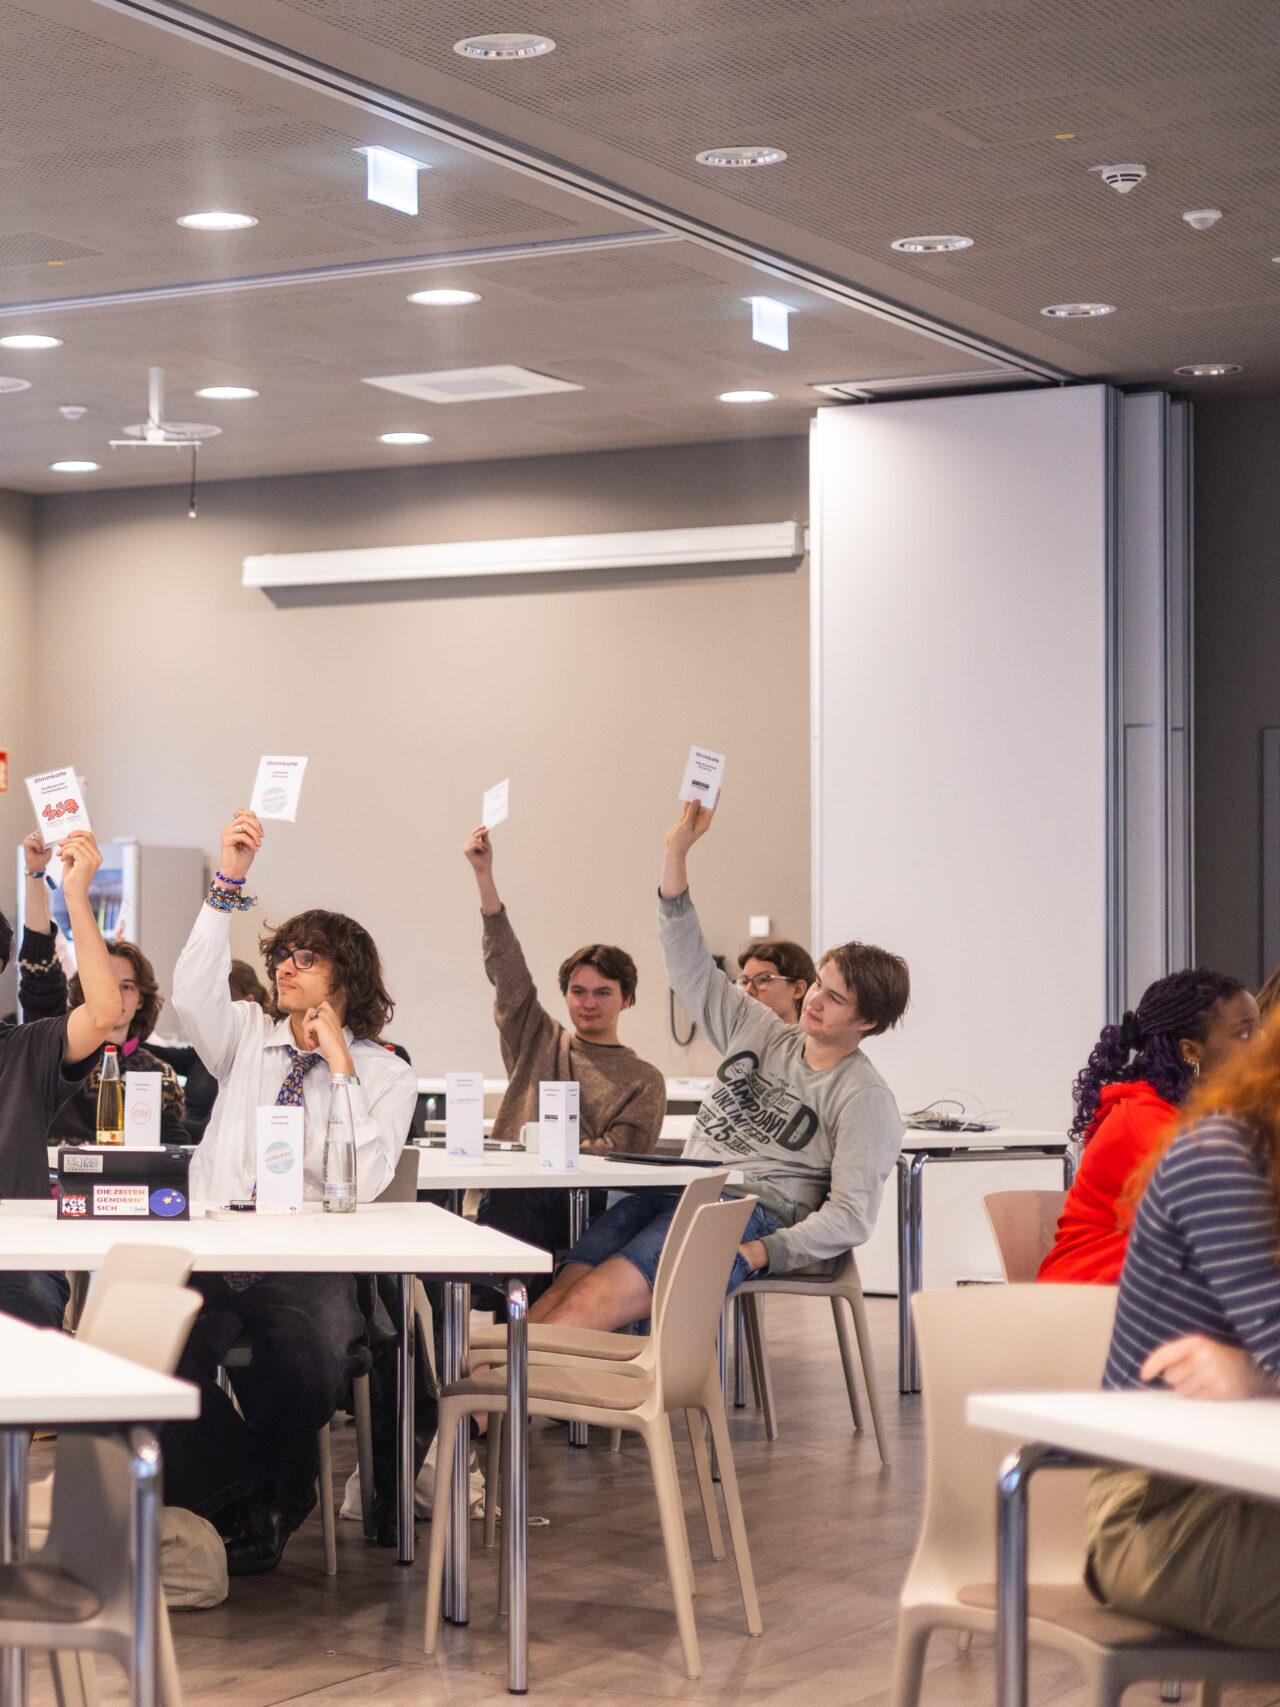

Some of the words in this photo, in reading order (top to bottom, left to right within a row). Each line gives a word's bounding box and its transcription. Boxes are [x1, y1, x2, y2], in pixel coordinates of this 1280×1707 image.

[33, 770, 67, 784] Stimmkarte
[703, 1116, 737, 1143] 25
[62, 1198, 87, 1207] FCK
[62, 1205, 87, 1213] NZS
